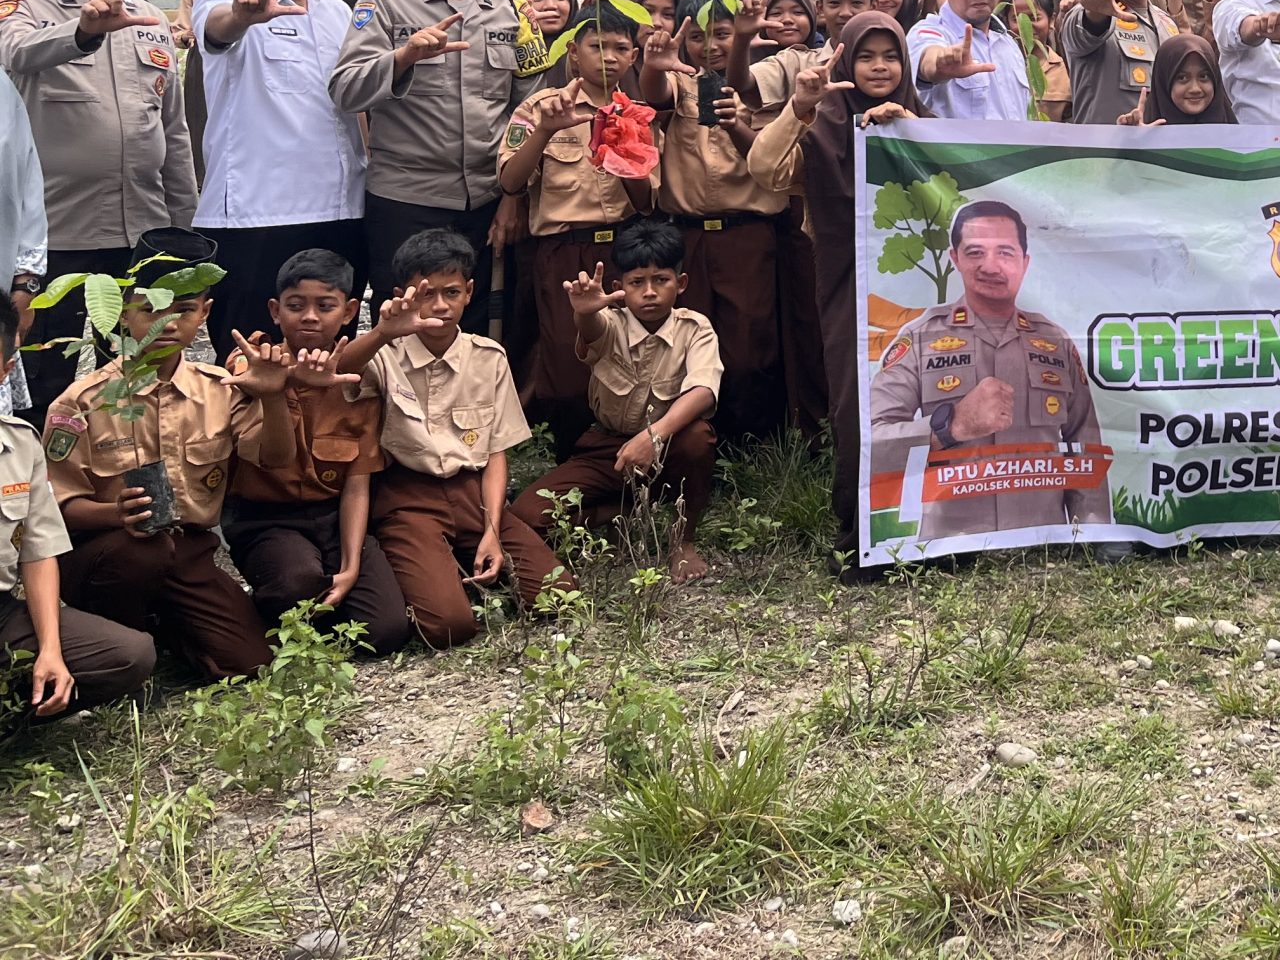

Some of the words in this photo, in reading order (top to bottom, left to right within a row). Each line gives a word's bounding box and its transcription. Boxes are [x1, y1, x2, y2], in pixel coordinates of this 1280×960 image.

[137, 30, 169, 45] POLRI
[1118, 31, 1146, 43] AZHARI
[926, 354, 971, 370] AZHARI
[1028, 352, 1065, 369] POLRI
[937, 464, 978, 483] IPTU
[983, 458, 1058, 478] AZHARI,
[1063, 458, 1094, 472] S.H
[952, 479, 1011, 496] KAPOLSEK
[1013, 476, 1067, 489] SINGINGI
